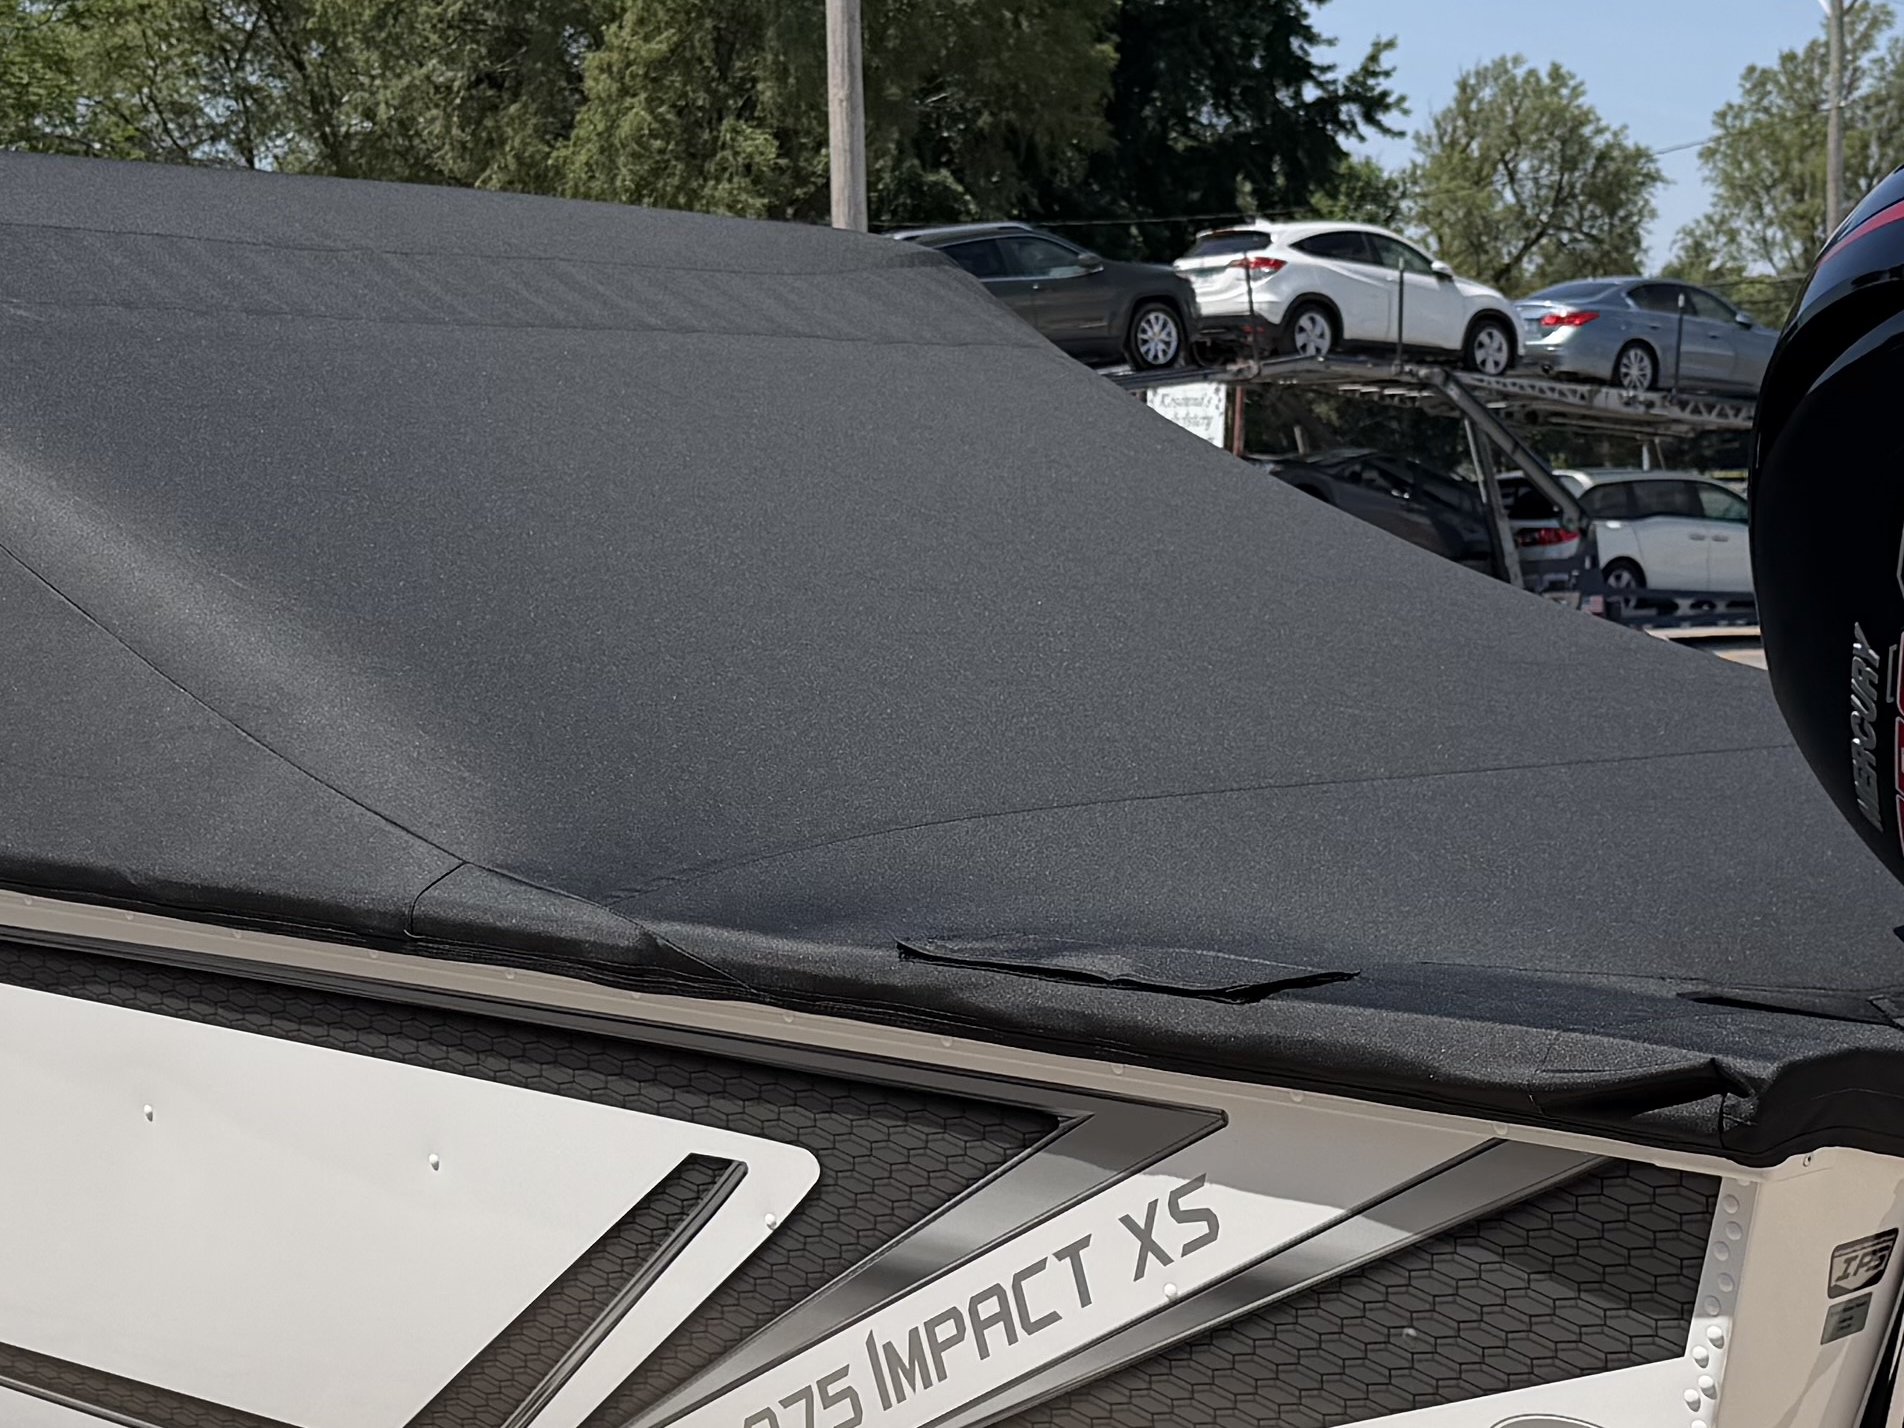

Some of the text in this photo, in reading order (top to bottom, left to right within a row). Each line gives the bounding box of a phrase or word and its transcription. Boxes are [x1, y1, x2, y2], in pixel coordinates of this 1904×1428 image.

[1851, 622, 1884, 832] MERCURY
[867, 1232, 1093, 1413] IMPACT
[1118, 1174, 1223, 1284] XS
